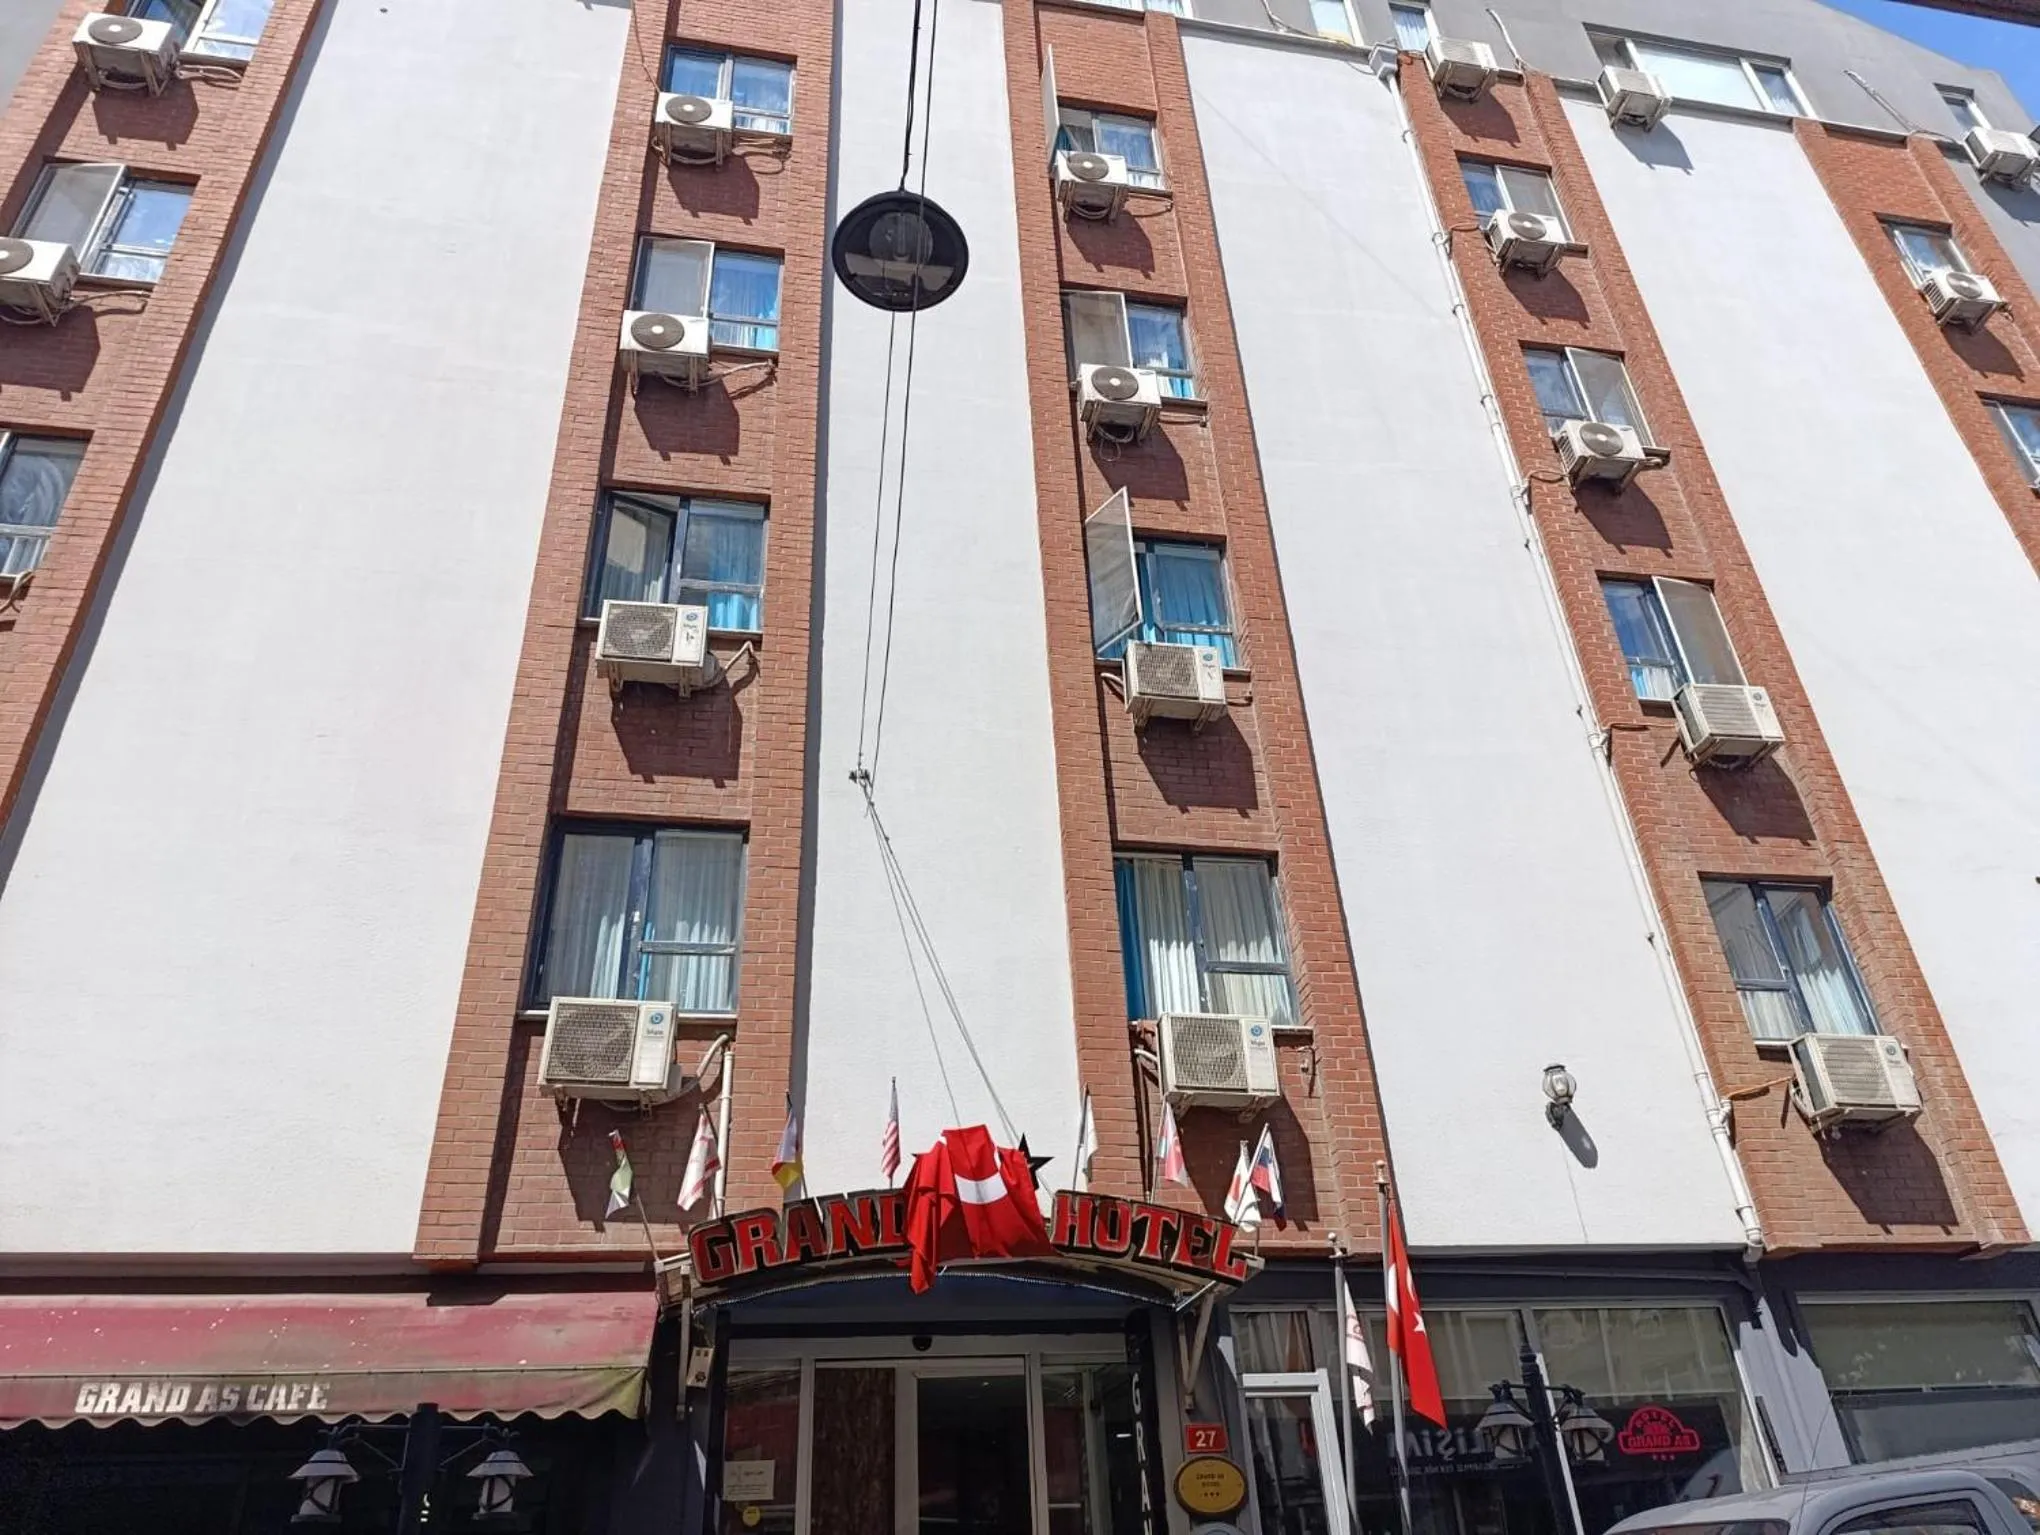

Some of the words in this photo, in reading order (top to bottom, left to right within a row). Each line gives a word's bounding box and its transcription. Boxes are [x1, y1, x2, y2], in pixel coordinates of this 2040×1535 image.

[1051, 1195, 1248, 1281] HOTEL
[75, 1383, 192, 1414] GRAND
[194, 1385, 241, 1413] AS
[246, 1383, 330, 1411] CAFE
[1195, 1430, 1217, 1448] 27
